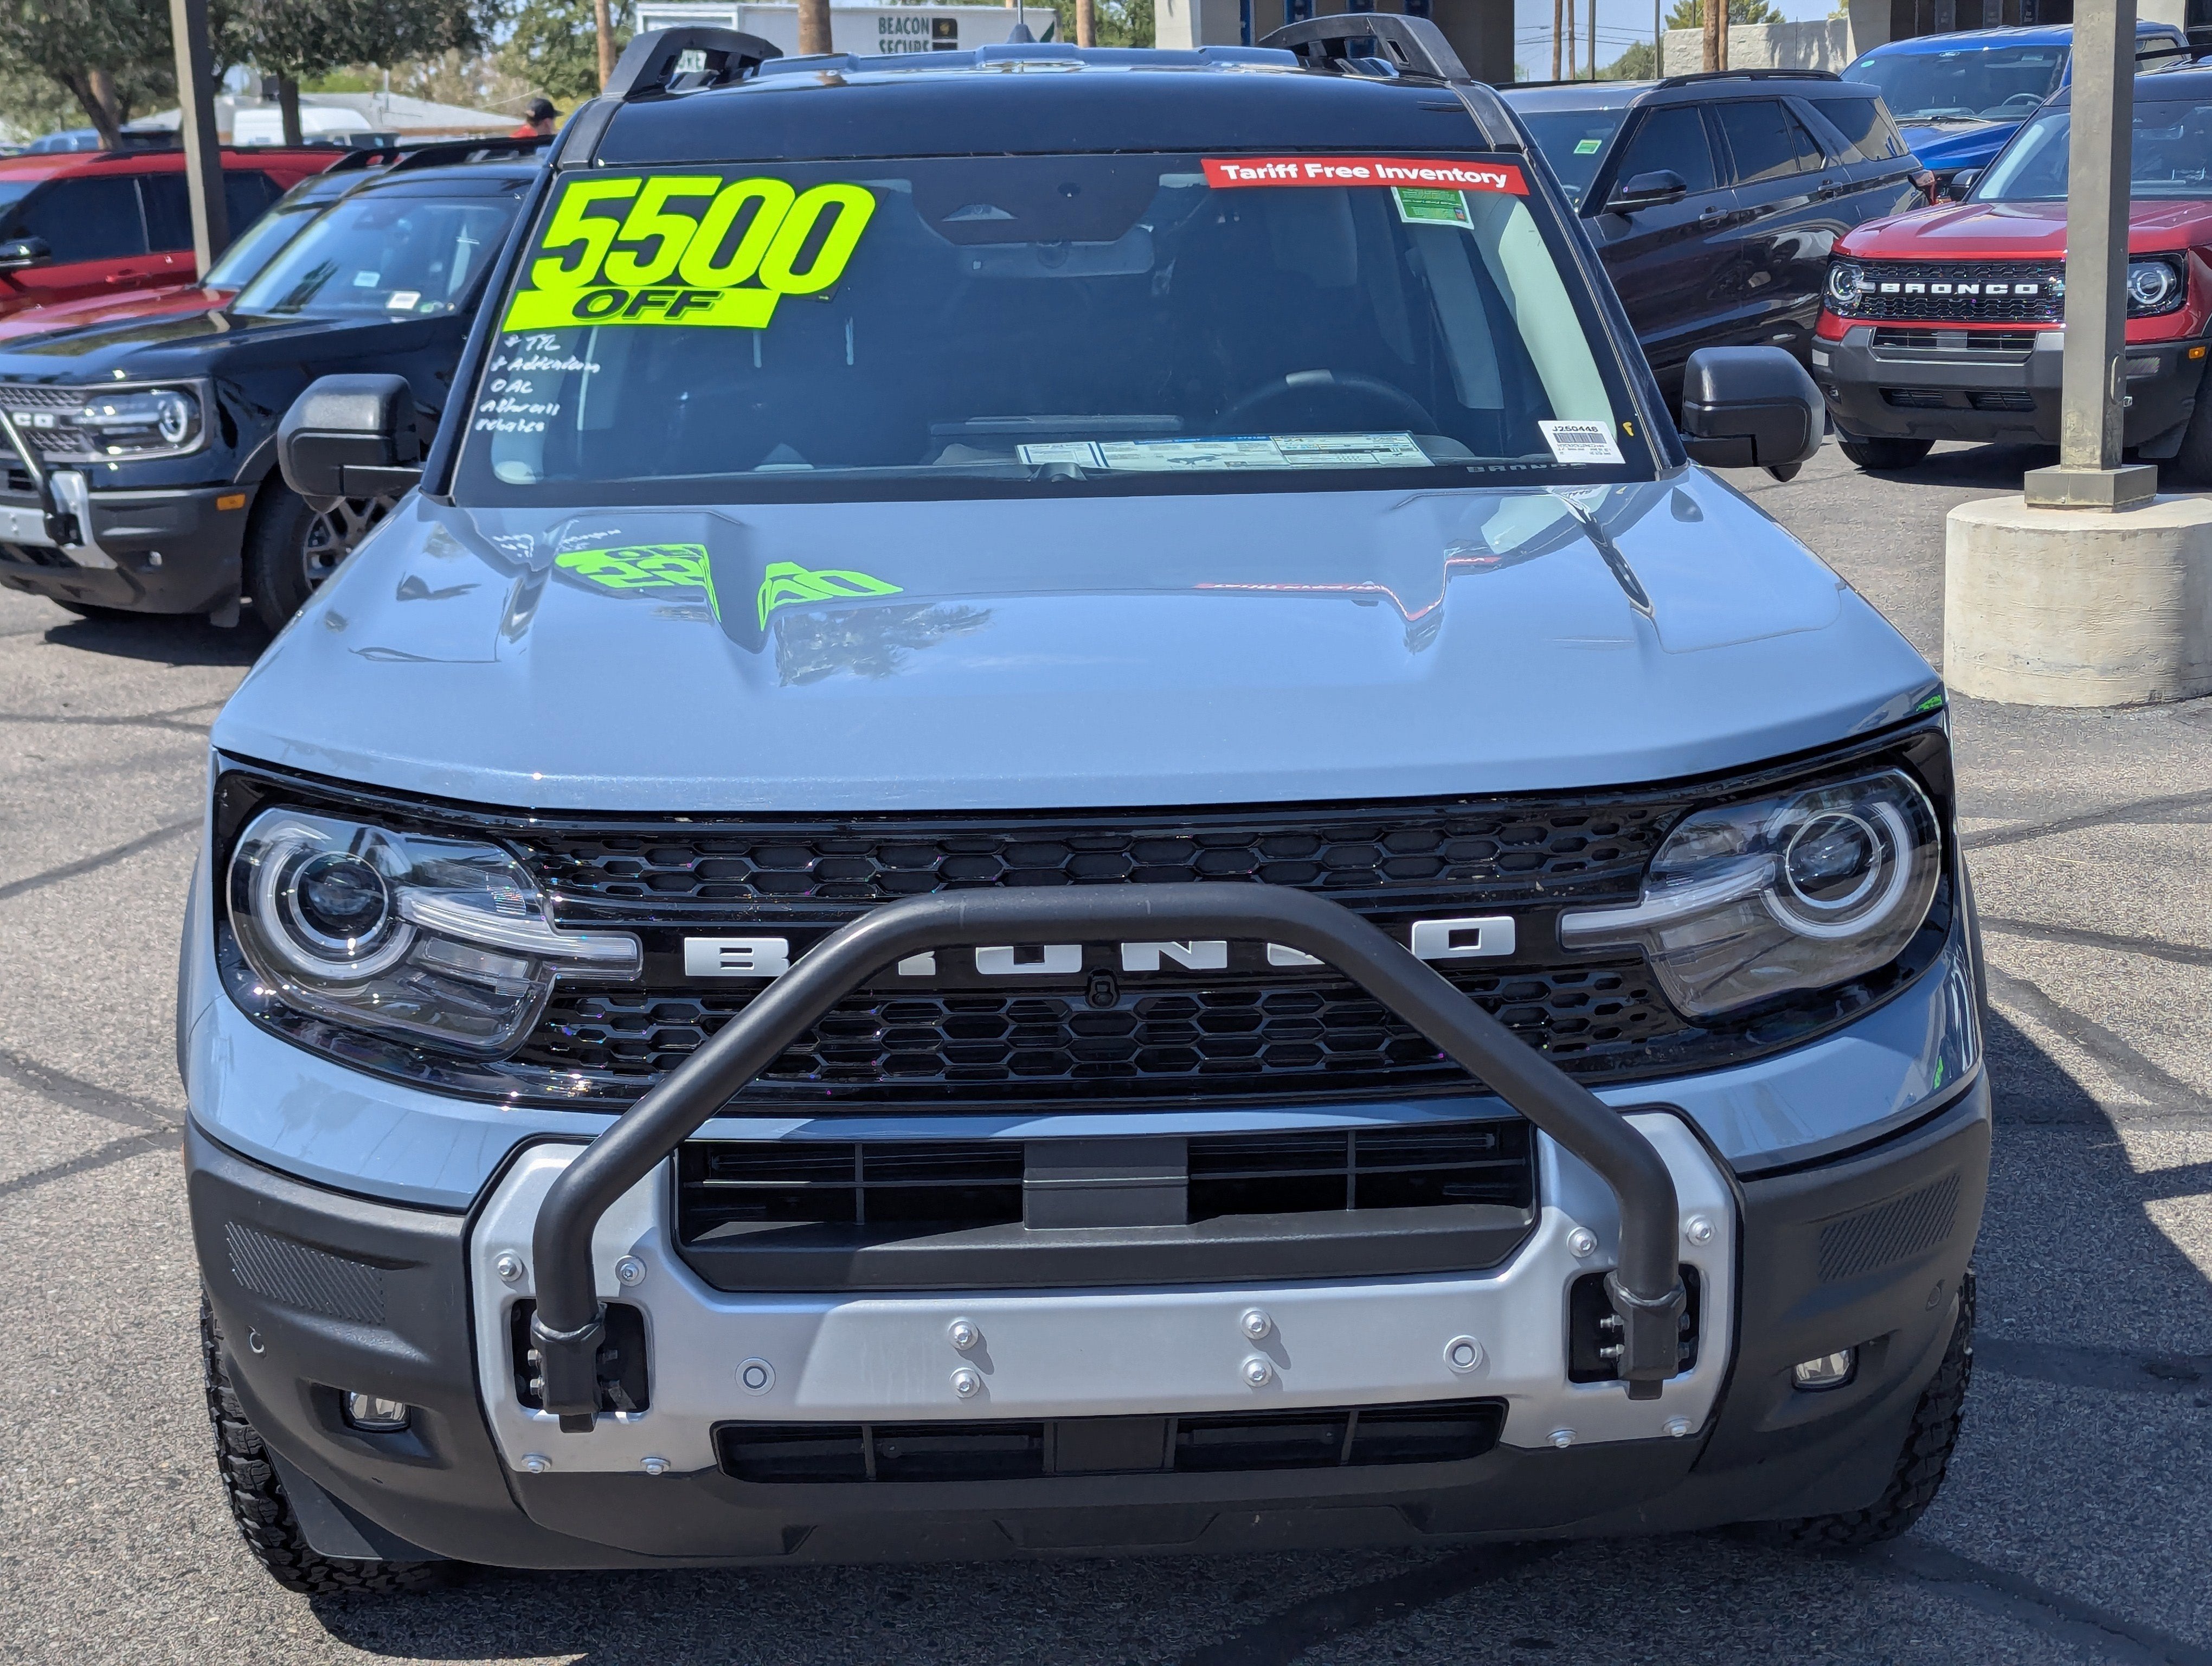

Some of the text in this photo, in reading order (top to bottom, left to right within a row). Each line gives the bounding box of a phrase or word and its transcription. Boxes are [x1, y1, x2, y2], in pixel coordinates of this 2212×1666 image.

[878, 17, 929, 34] BEACON
[1220, 163, 1507, 189] Tariff Free Inventory
[531, 175, 876, 294] 5500
[1880, 283, 2038, 294] BRONCO
[571, 289, 725, 321] OFF
